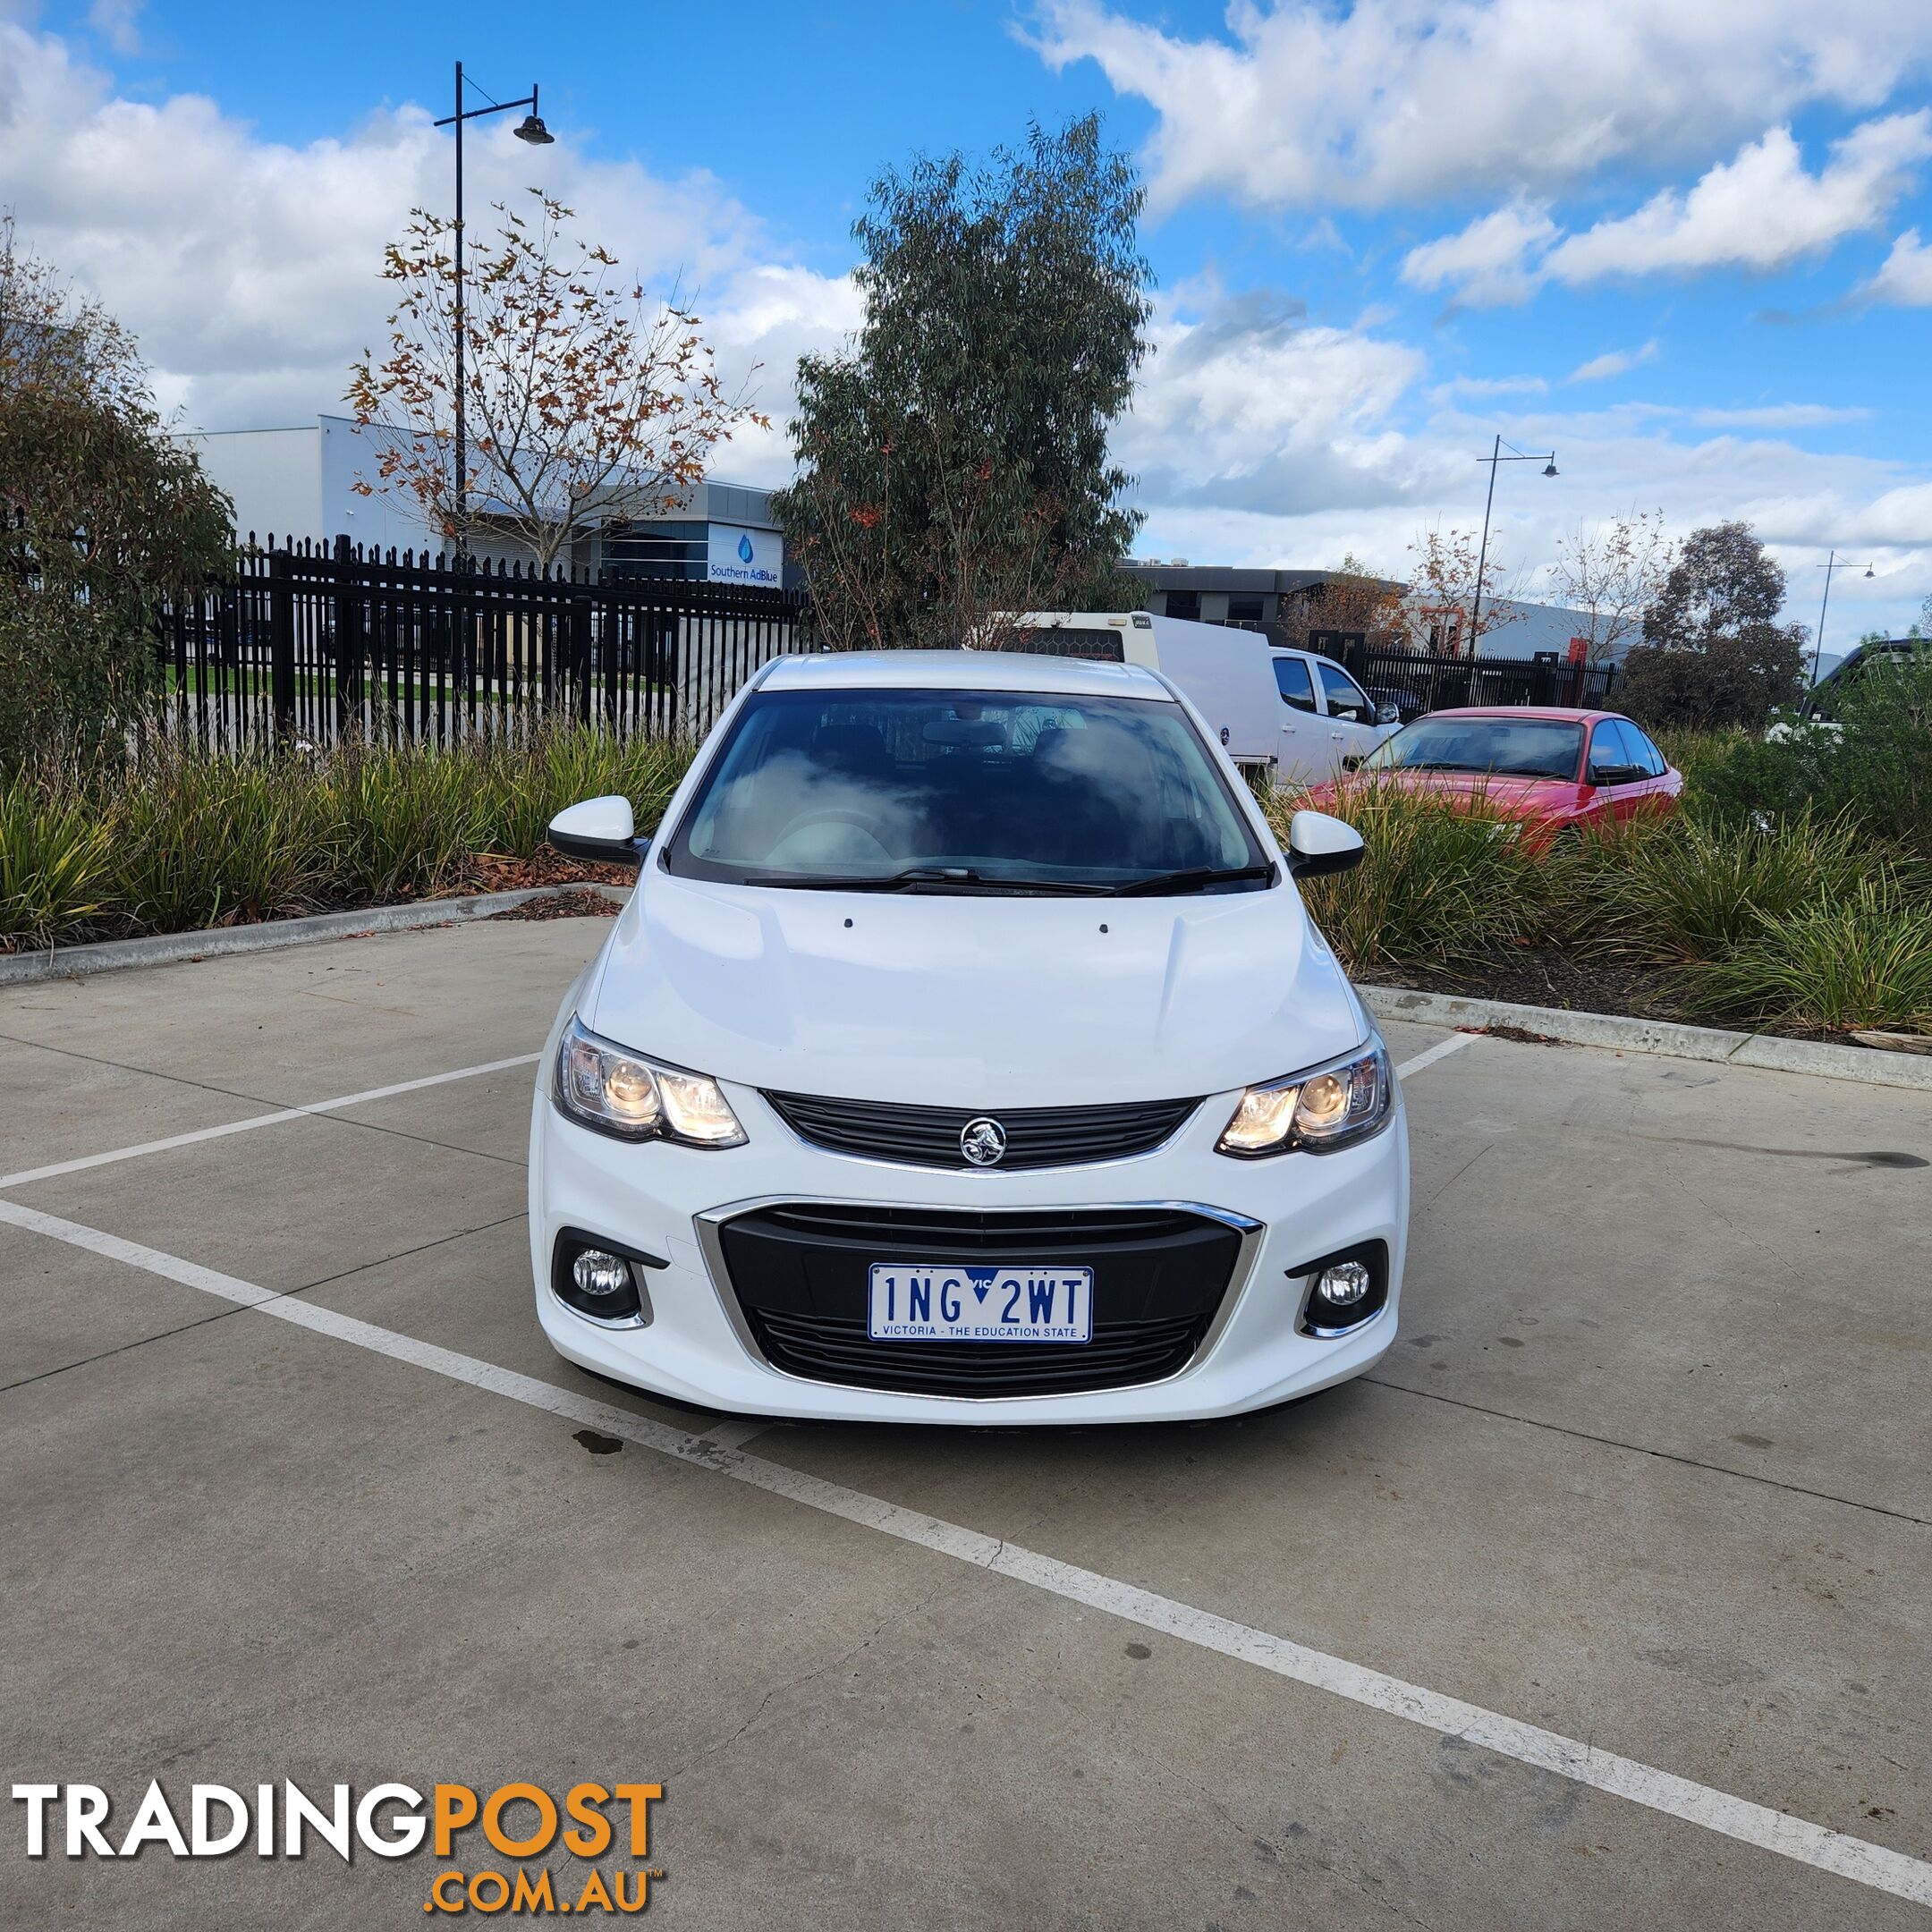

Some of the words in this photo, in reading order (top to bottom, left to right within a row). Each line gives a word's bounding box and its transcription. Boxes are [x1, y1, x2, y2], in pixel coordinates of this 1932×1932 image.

[711, 564, 749, 579] Southern
[750, 569, 777, 582] AdBlue
[969, 1279, 992, 1289] VIC
[885, 1276, 961, 1323] 1NG
[1001, 1280, 1082, 1324] 2WT
[883, 1325, 936, 1335] VICTORIA
[949, 1326, 970, 1336] THE
[975, 1326, 1039, 1337] EDUCATION
[1044, 1328, 1077, 1337] STATE
